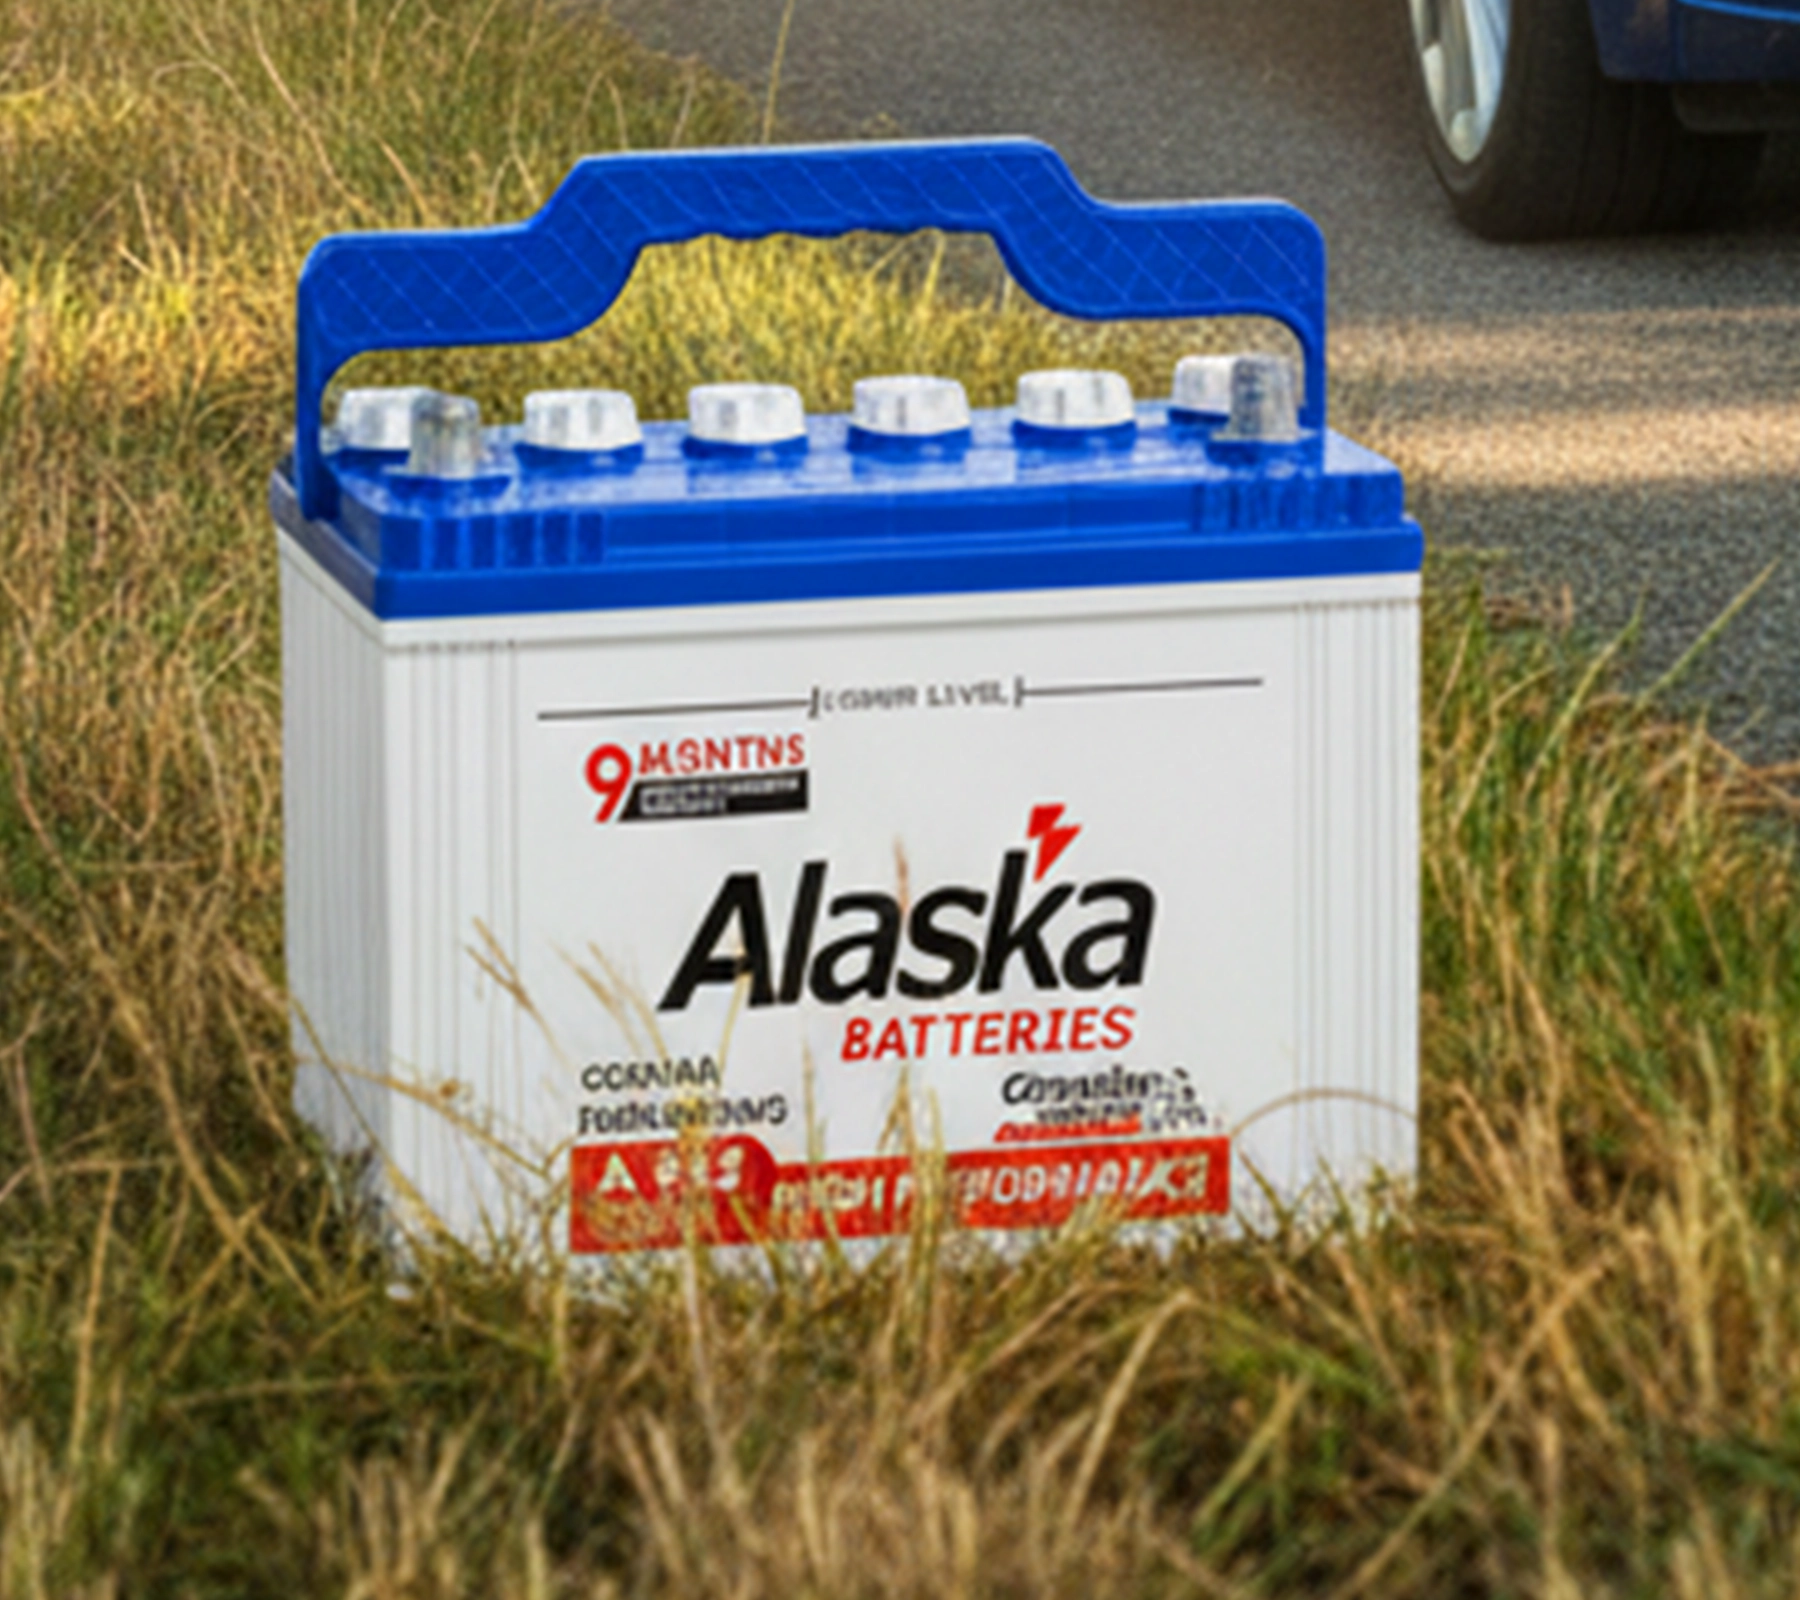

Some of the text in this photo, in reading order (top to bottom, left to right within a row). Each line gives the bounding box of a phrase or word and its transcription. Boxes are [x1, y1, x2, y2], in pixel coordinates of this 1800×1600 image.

[585, 743, 632, 823] 9
[657, 850, 1156, 1012] Alaska
[840, 1007, 1135, 1061] BATTERIES
